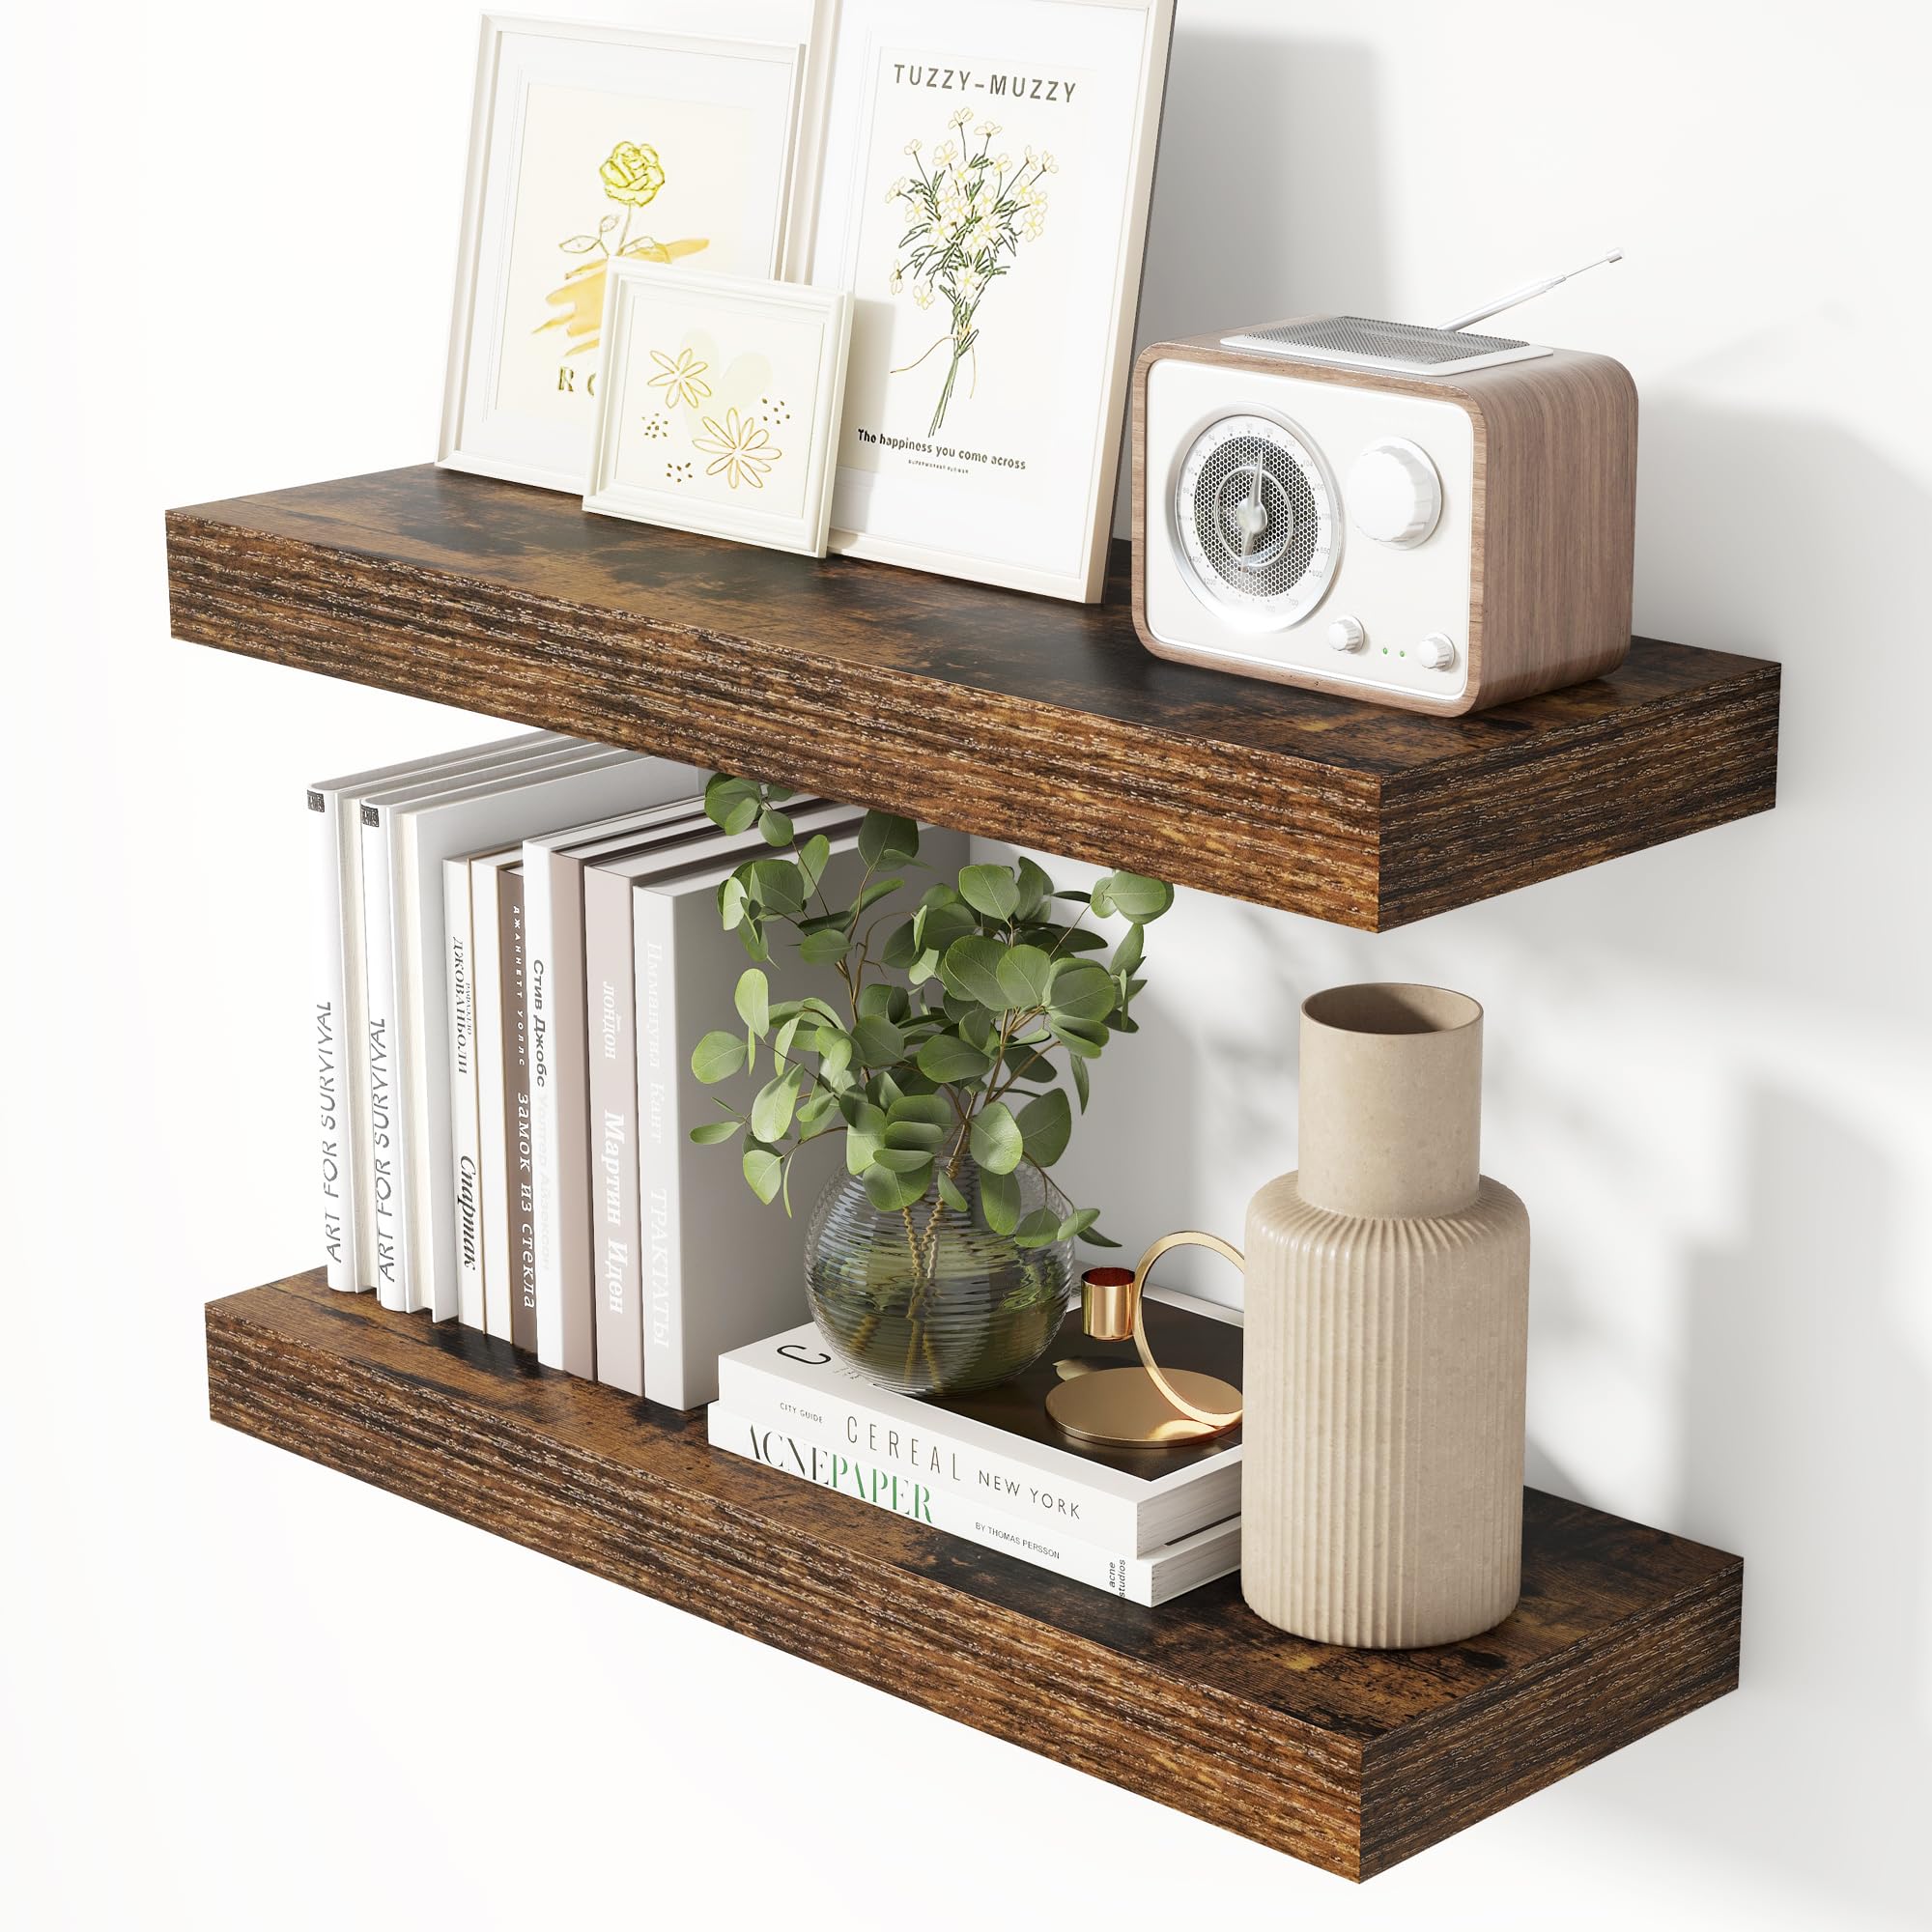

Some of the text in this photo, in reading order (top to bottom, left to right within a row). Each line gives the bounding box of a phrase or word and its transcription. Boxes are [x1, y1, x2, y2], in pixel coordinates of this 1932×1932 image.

[894, 64, 1076, 102] TUZZY-MUZZY
[857, 428, 1026, 470] The happiness you come across
[513, 906, 523, 999] ДЖАННЕТТ
[533, 959, 545, 1010] Стив
[452, 936, 468, 1075] ДЖОВАНЬОЛИ
[533, 1014, 548, 1088] Джобс
[317, 1001, 342, 1264] ART FOR SURVIVAL
[369, 1018, 395, 1283] ART FOR SURVIVAL
[457, 1155, 476, 1271] Спартак
[601, 1109, 629, 1316] Мартин Иден
[650, 1187, 670, 1350] ТРАКТАТЫ
[780, 1403, 823, 1424] CITY GUIDE
[847, 1415, 1081, 1520] CEREAL NEW YORK
[975, 1521, 1061, 1560] BY THOMAS PERSSON
[1118, 1559, 1126, 1598] studios
